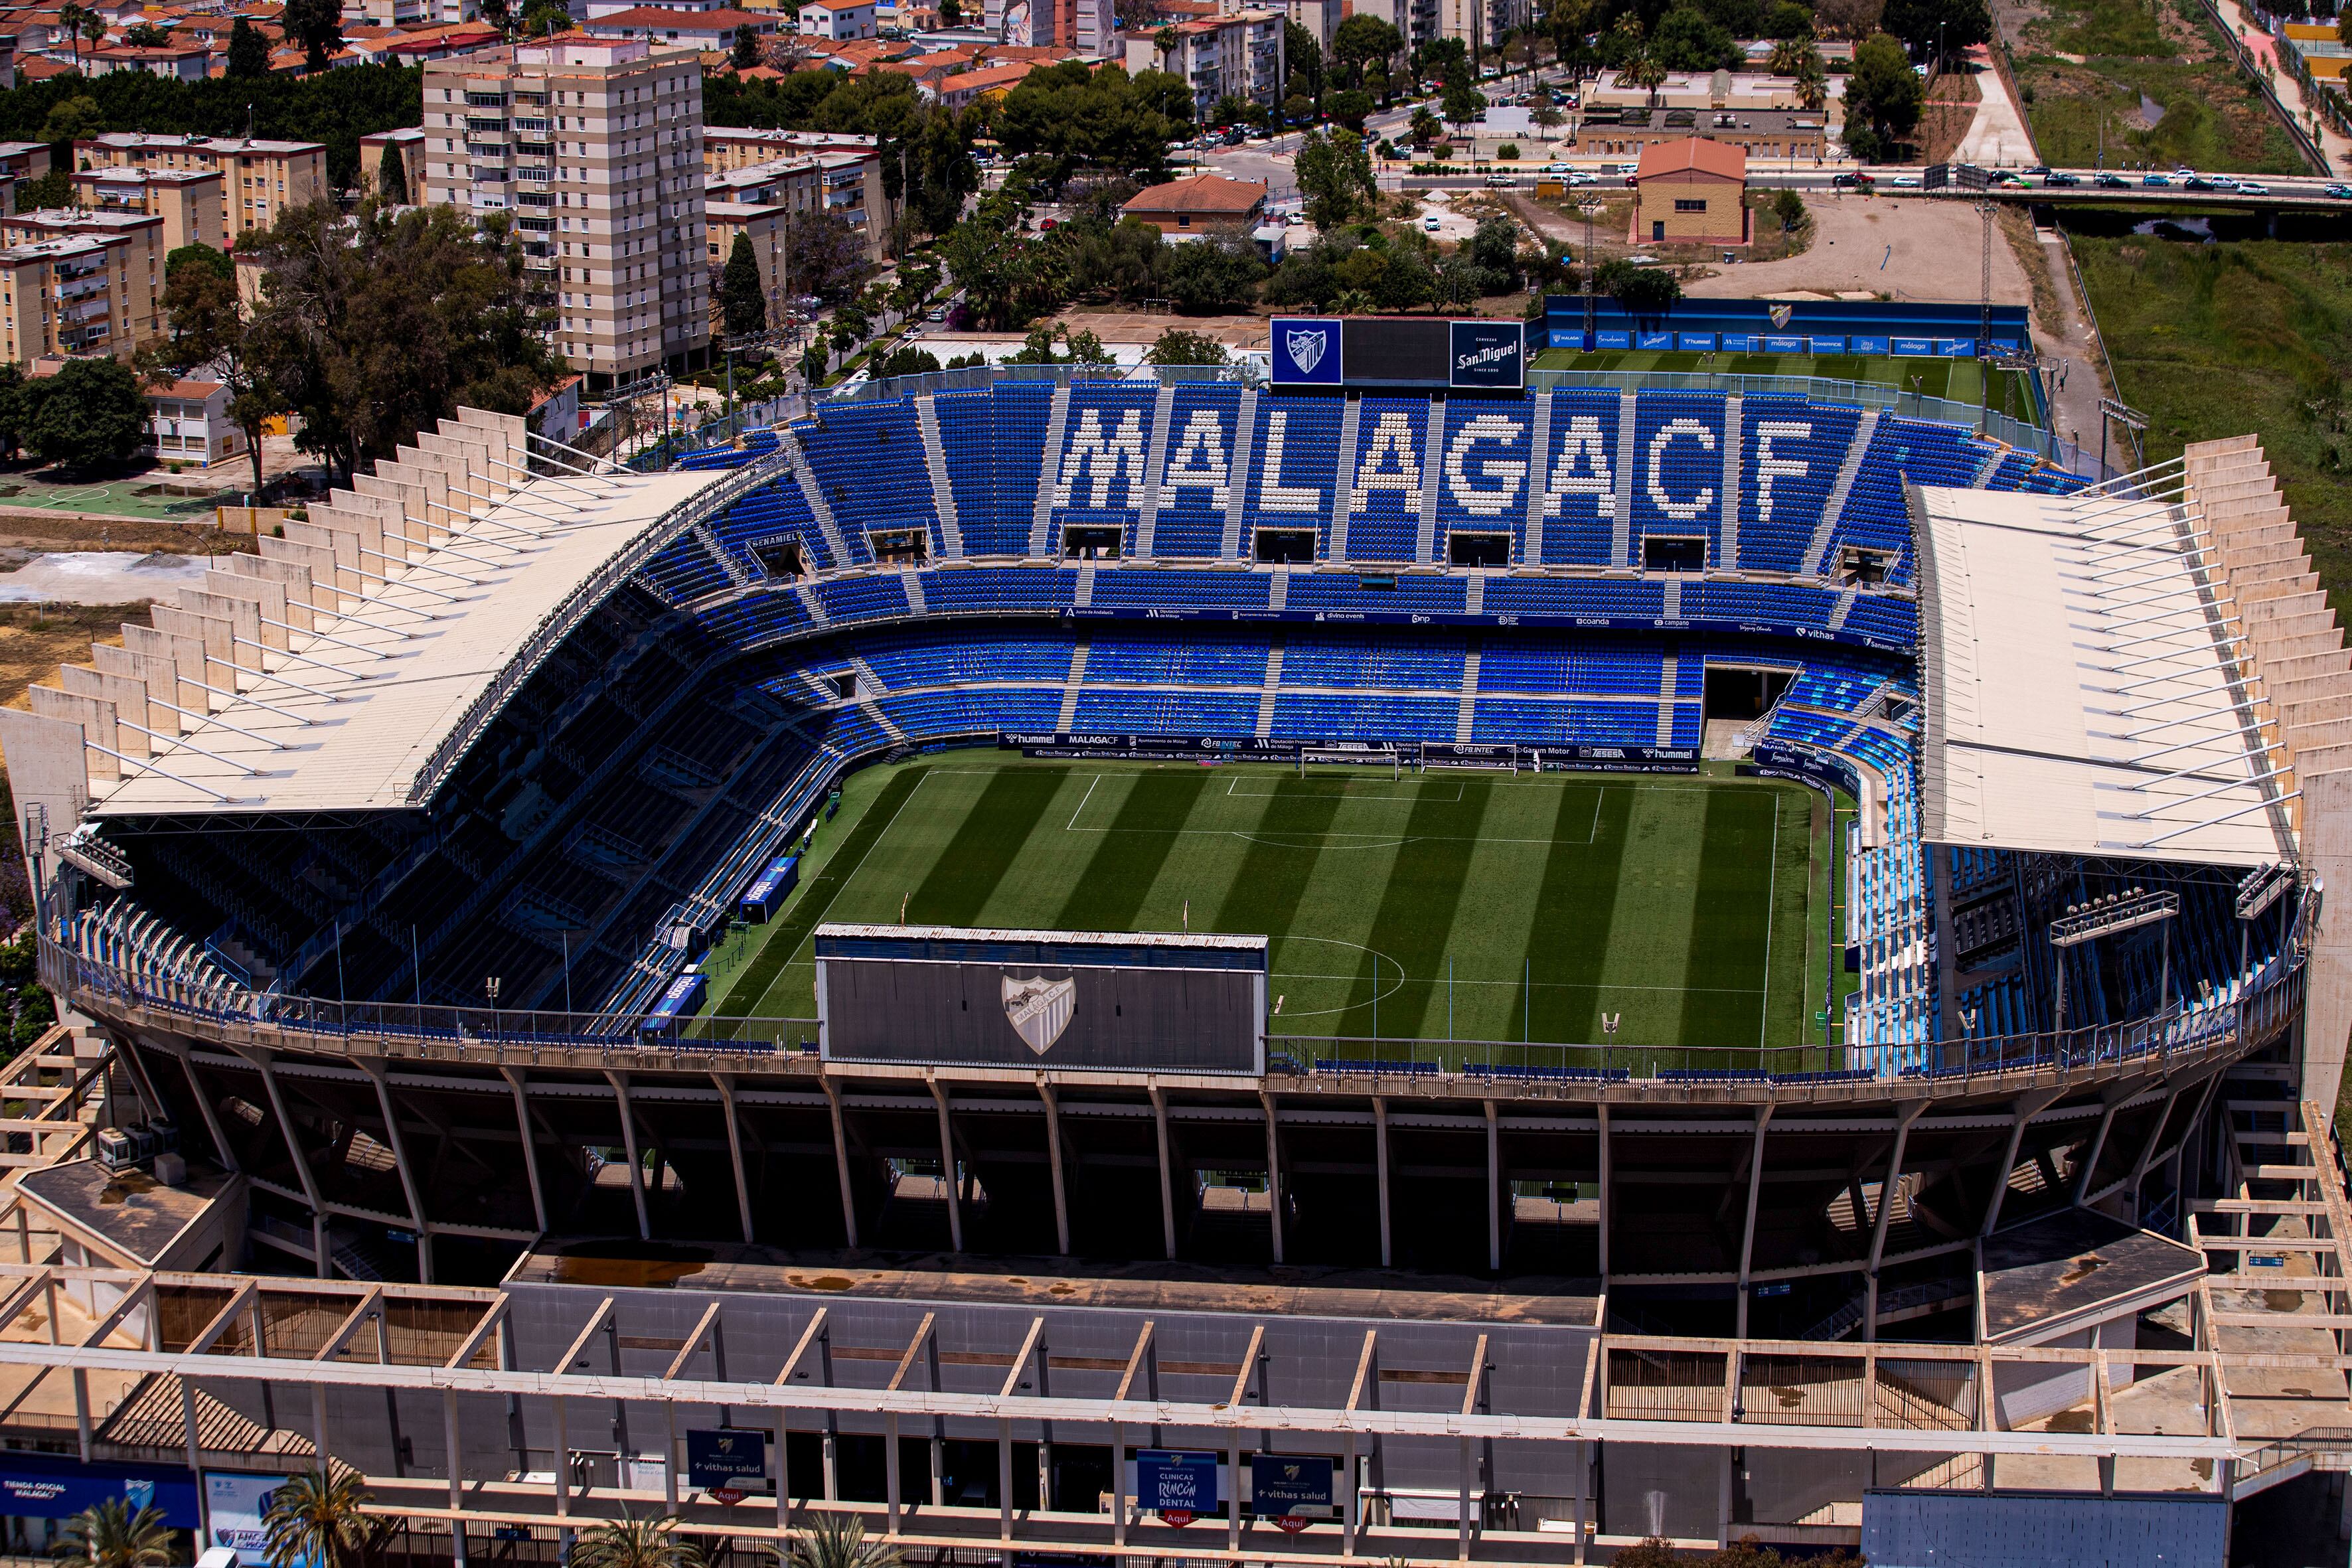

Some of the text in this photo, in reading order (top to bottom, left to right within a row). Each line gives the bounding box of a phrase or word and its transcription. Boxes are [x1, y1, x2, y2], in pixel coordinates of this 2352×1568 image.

[752, 533, 797, 548] BENAMIEL
[1808, 629, 1835, 640] vithas
[1871, 641, 1895, 651] Sanamar
[1018, 735, 1055, 744] hummel
[1592, 749, 1626, 758] TESESA
[1655, 749, 1692, 759] hummel
[1048, 986, 1063, 998] C.F.
[704, 1462, 733, 1472] vithas
[3, 1480, 66, 1493] TIENDA OFICIAL
[1268, 1490, 1326, 1500] vithas salud
[1160, 1498, 1196, 1508] DENTAL
